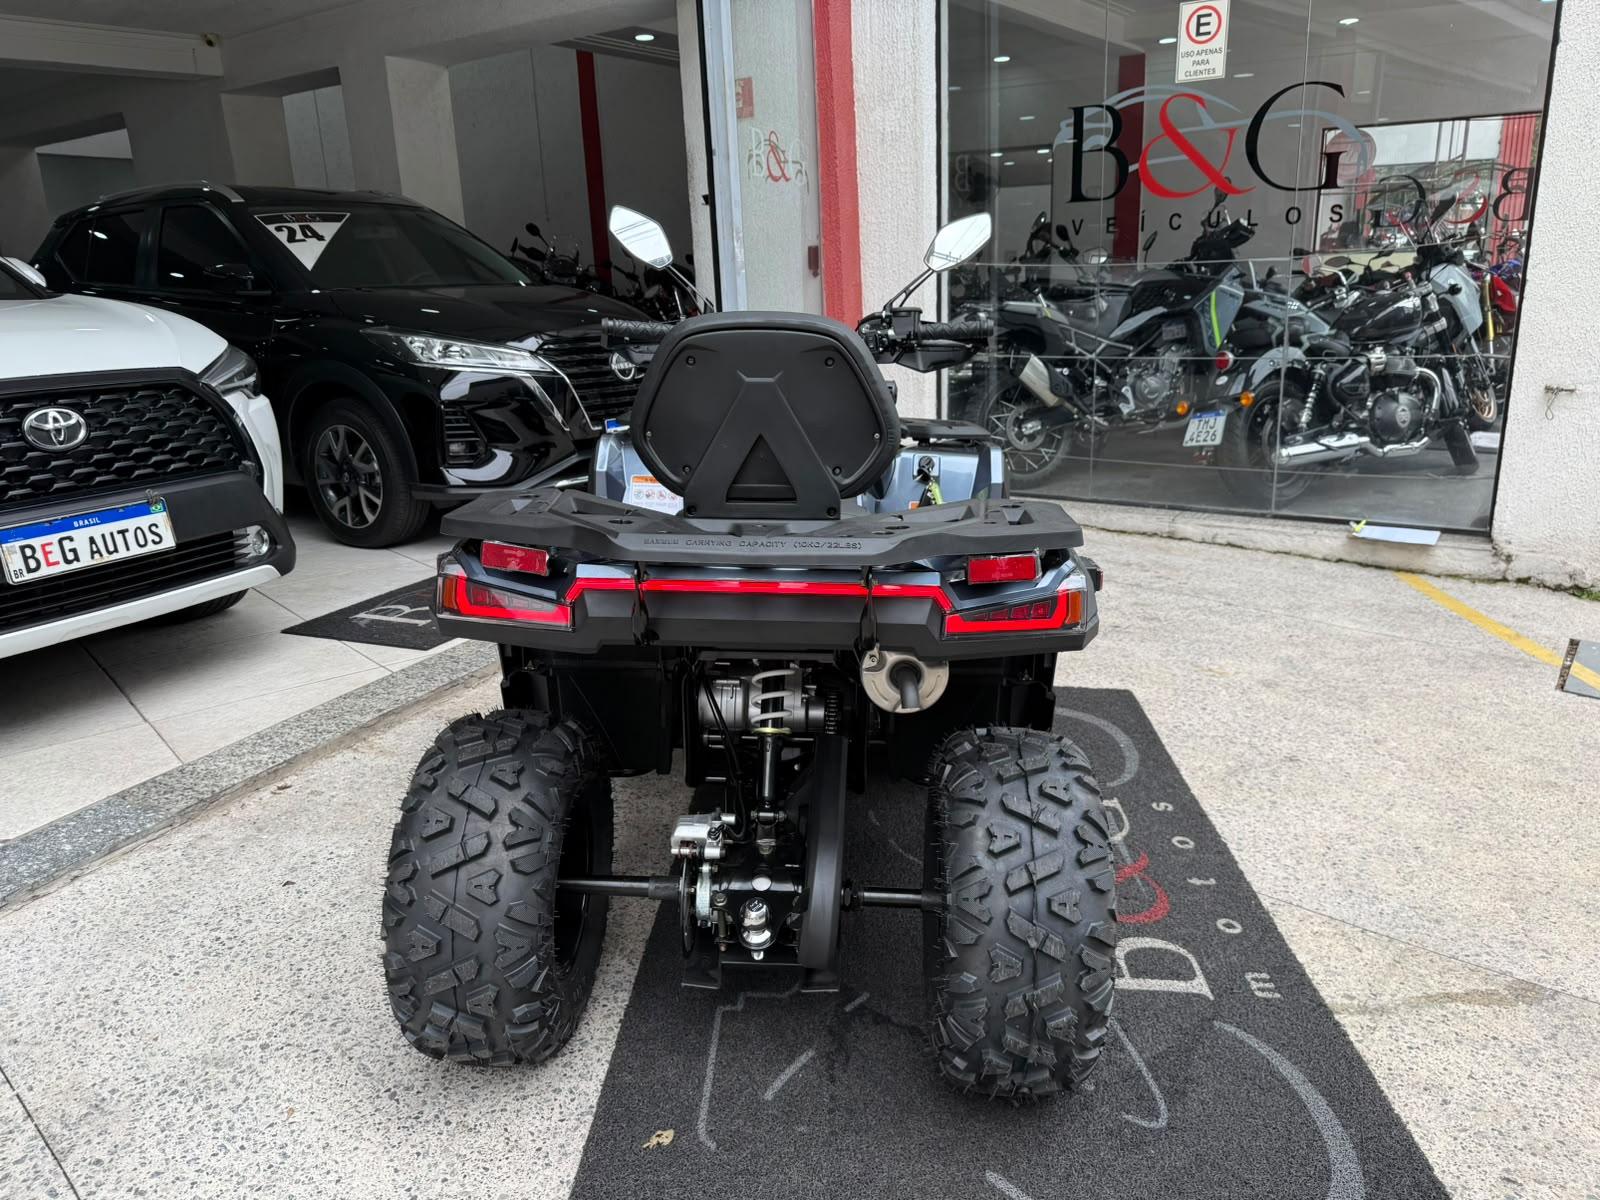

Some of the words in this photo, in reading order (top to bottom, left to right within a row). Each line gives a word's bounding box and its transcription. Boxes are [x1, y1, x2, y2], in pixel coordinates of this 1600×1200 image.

[1196, 13, 1212, 37] E
[1181, 50, 1195, 58] USO
[1196, 47, 1223, 56] APENAS
[1192, 59, 1210, 67] PARA
[1184, 68, 1216, 78] CLIENTES
[1066, 81, 1346, 203] B&G
[1071, 203, 1344, 237] VEÍCULOS
[274, 224, 326, 243] 24
[1196, 417, 1217, 431] TMJ
[1188, 430, 1217, 443] 4E26
[73, 517, 101, 528] BRASIL
[19, 535, 81, 575] BEG
[89, 523, 163, 560] AUTOS
[685, 539, 732, 547] CARRYING
[738, 540, 785, 549] CAPACITY
[13, 568, 25, 580] BR
